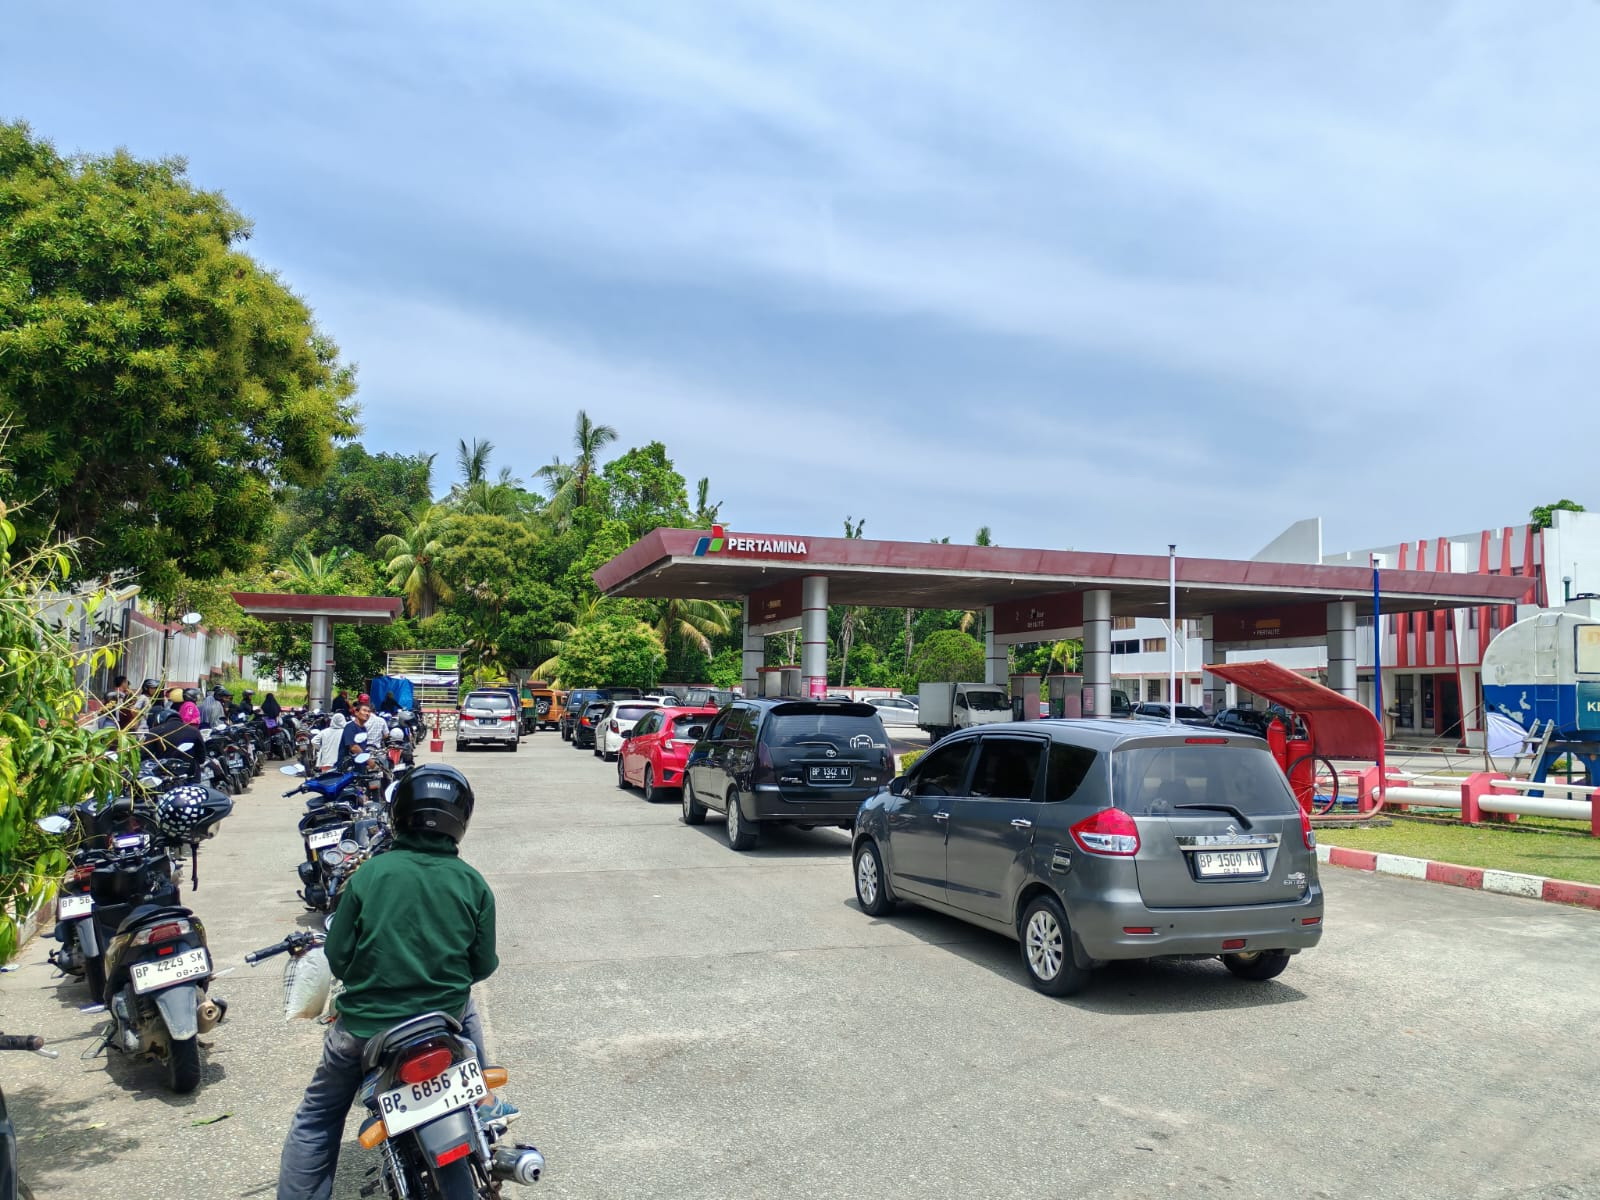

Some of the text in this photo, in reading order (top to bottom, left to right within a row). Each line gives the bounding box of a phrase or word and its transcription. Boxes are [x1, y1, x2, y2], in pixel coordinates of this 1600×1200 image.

[728, 538, 807, 554] PERTAMINA
[812, 766, 821, 776] BP
[426, 781, 451, 791] YAMAHA
[1199, 851, 1261, 868] BP 1509 KY
[62, 895, 92, 908] BP 56
[135, 965, 149, 979] BP
[190, 951, 204, 963] SK
[382, 1062, 480, 1114] BP 6856 KR
